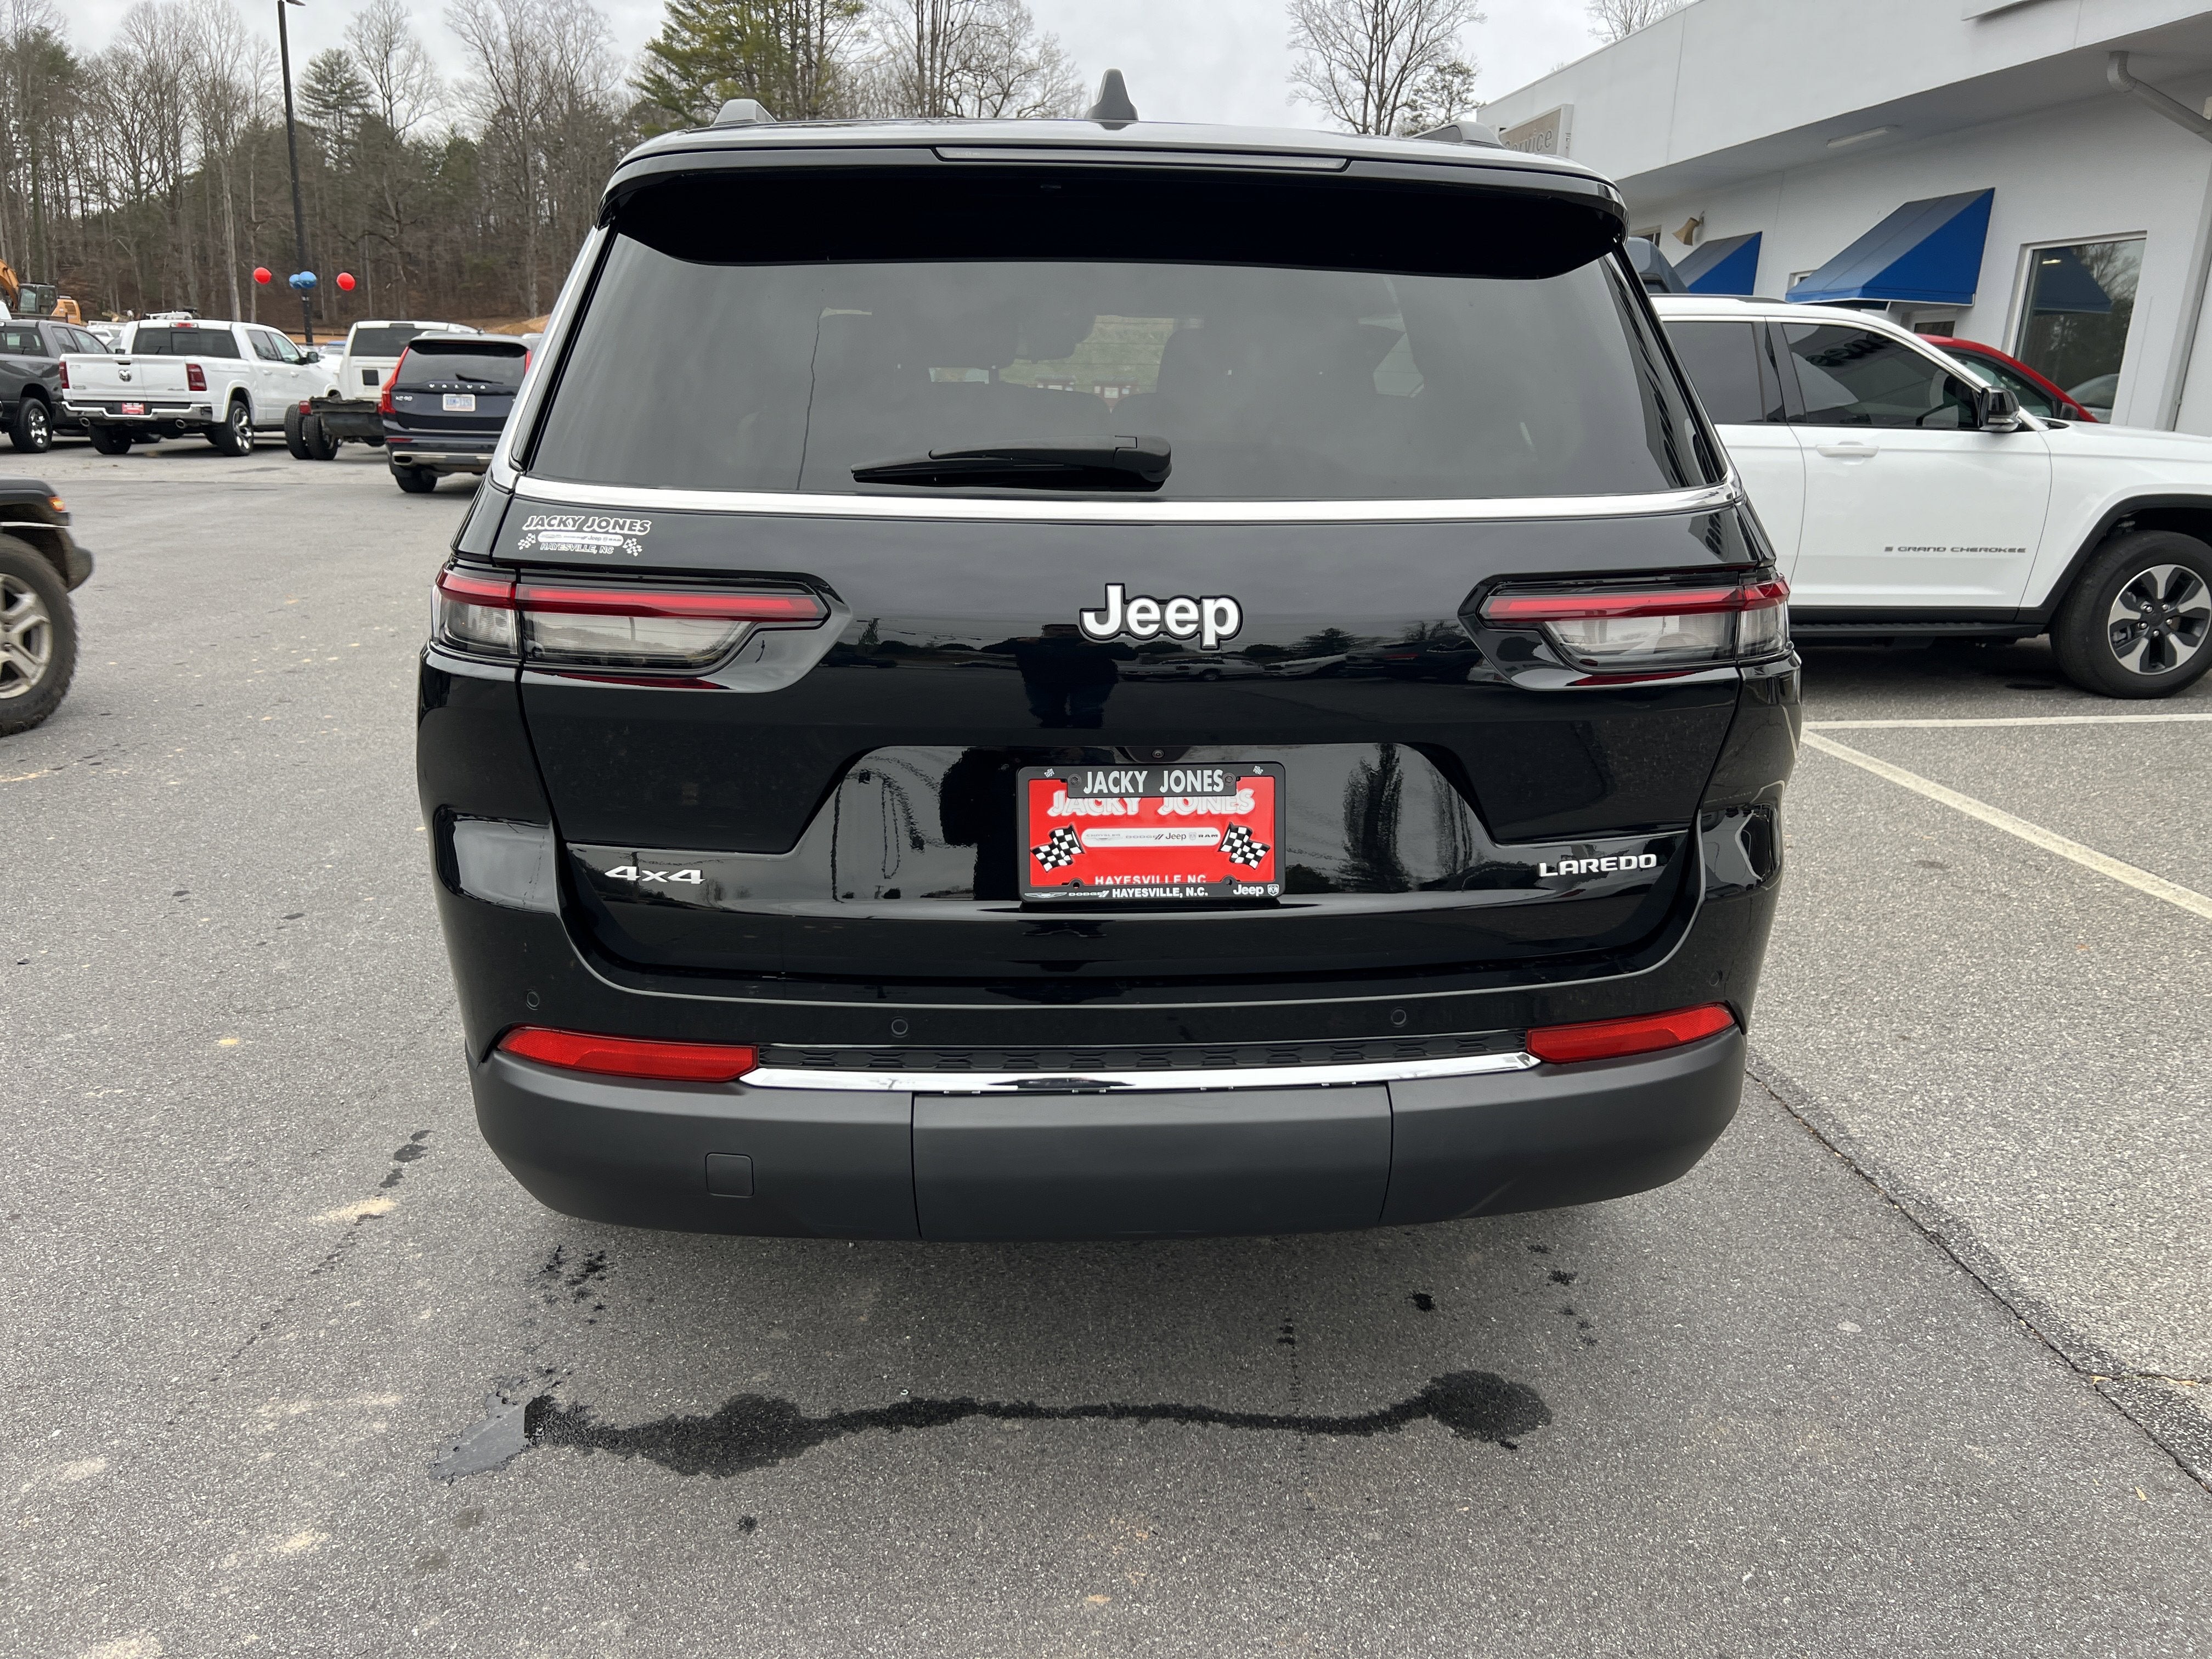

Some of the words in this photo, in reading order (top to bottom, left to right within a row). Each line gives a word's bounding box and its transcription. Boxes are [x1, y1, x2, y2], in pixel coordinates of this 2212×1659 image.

[522, 516, 585, 531] JACKY
[583, 517, 652, 535] JONES
[540, 543, 598, 554] HAYESVILLE,
[599, 545, 614, 554] NC
[1080, 583, 1243, 650] Jeep
[1083, 770, 1148, 794] JACKY
[1159, 769, 1224, 793] JONES
[1047, 790, 1142, 816] JACKY
[1157, 789, 1256, 816] JONES
[605, 865, 706, 884] 4x4
[1538, 854, 1657, 877] LAREDO
[1112, 888, 1183, 898] HAYESVILLE,
[1186, 887, 1209, 896] N.C.
[1233, 884, 1264, 897] Jeep
